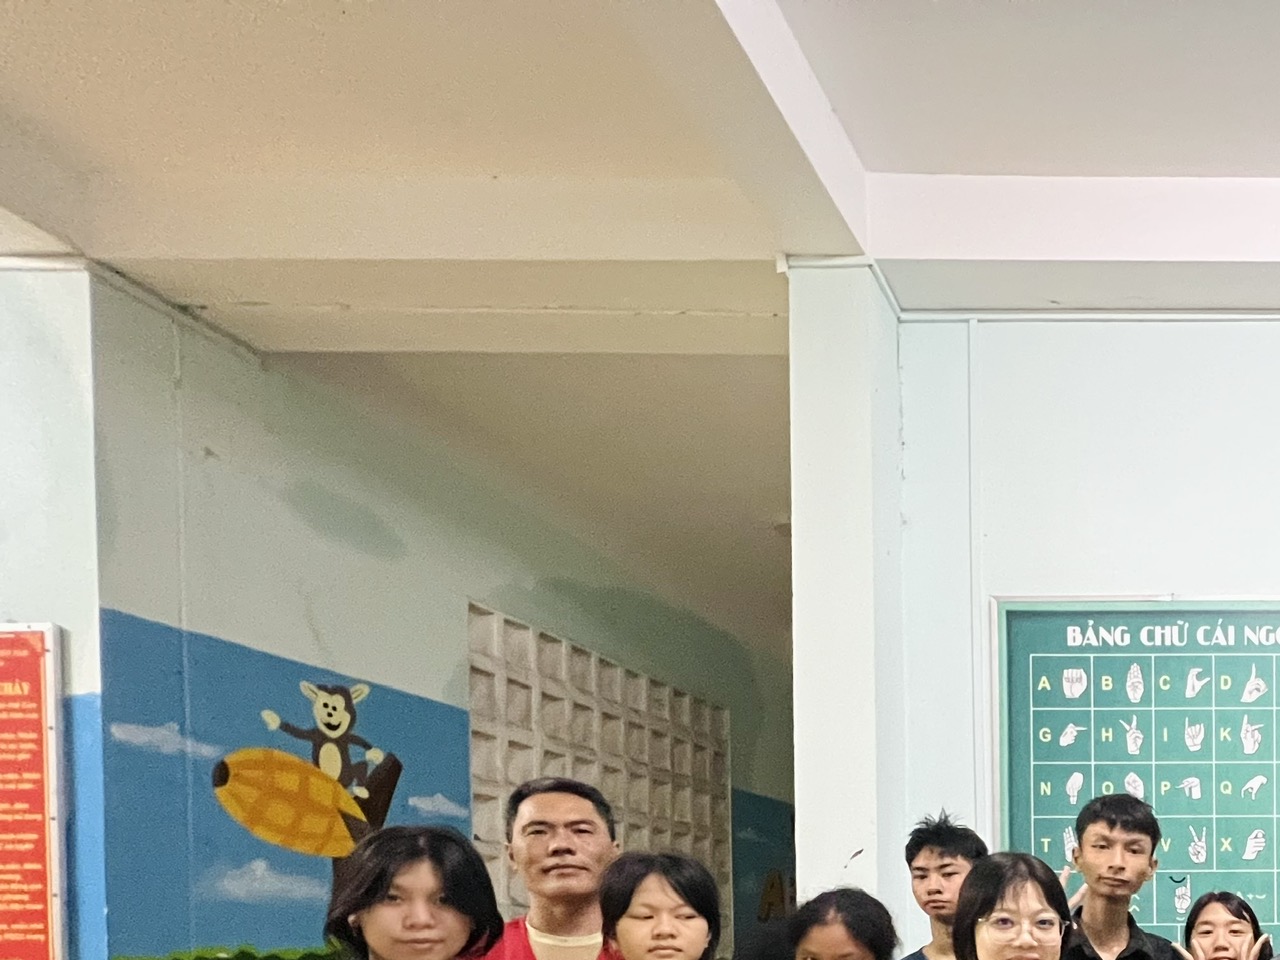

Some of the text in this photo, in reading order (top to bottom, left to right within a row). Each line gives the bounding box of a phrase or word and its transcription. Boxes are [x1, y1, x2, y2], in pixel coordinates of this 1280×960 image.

[1066, 620, 1131, 646] BẢNG
[1139, 620, 1190, 646] CHỮ
[1196, 619, 1236, 646] CÁI
[1038, 676, 1051, 691] A
[1102, 676, 1113, 690] B
[1159, 676, 1171, 690] C
[1220, 676, 1232, 690] D
[1039, 727, 1052, 742] G
[1102, 728, 1113, 742] H
[1163, 728, 1168, 742] I
[1220, 728, 1232, 742] K
[1040, 782, 1051, 796] N
[1161, 782, 1171, 796] P
[1220, 781, 1232, 797] Q
[1041, 838, 1052, 852] T
[1161, 839, 1171, 852] V
[1220, 838, 1232, 852] X
